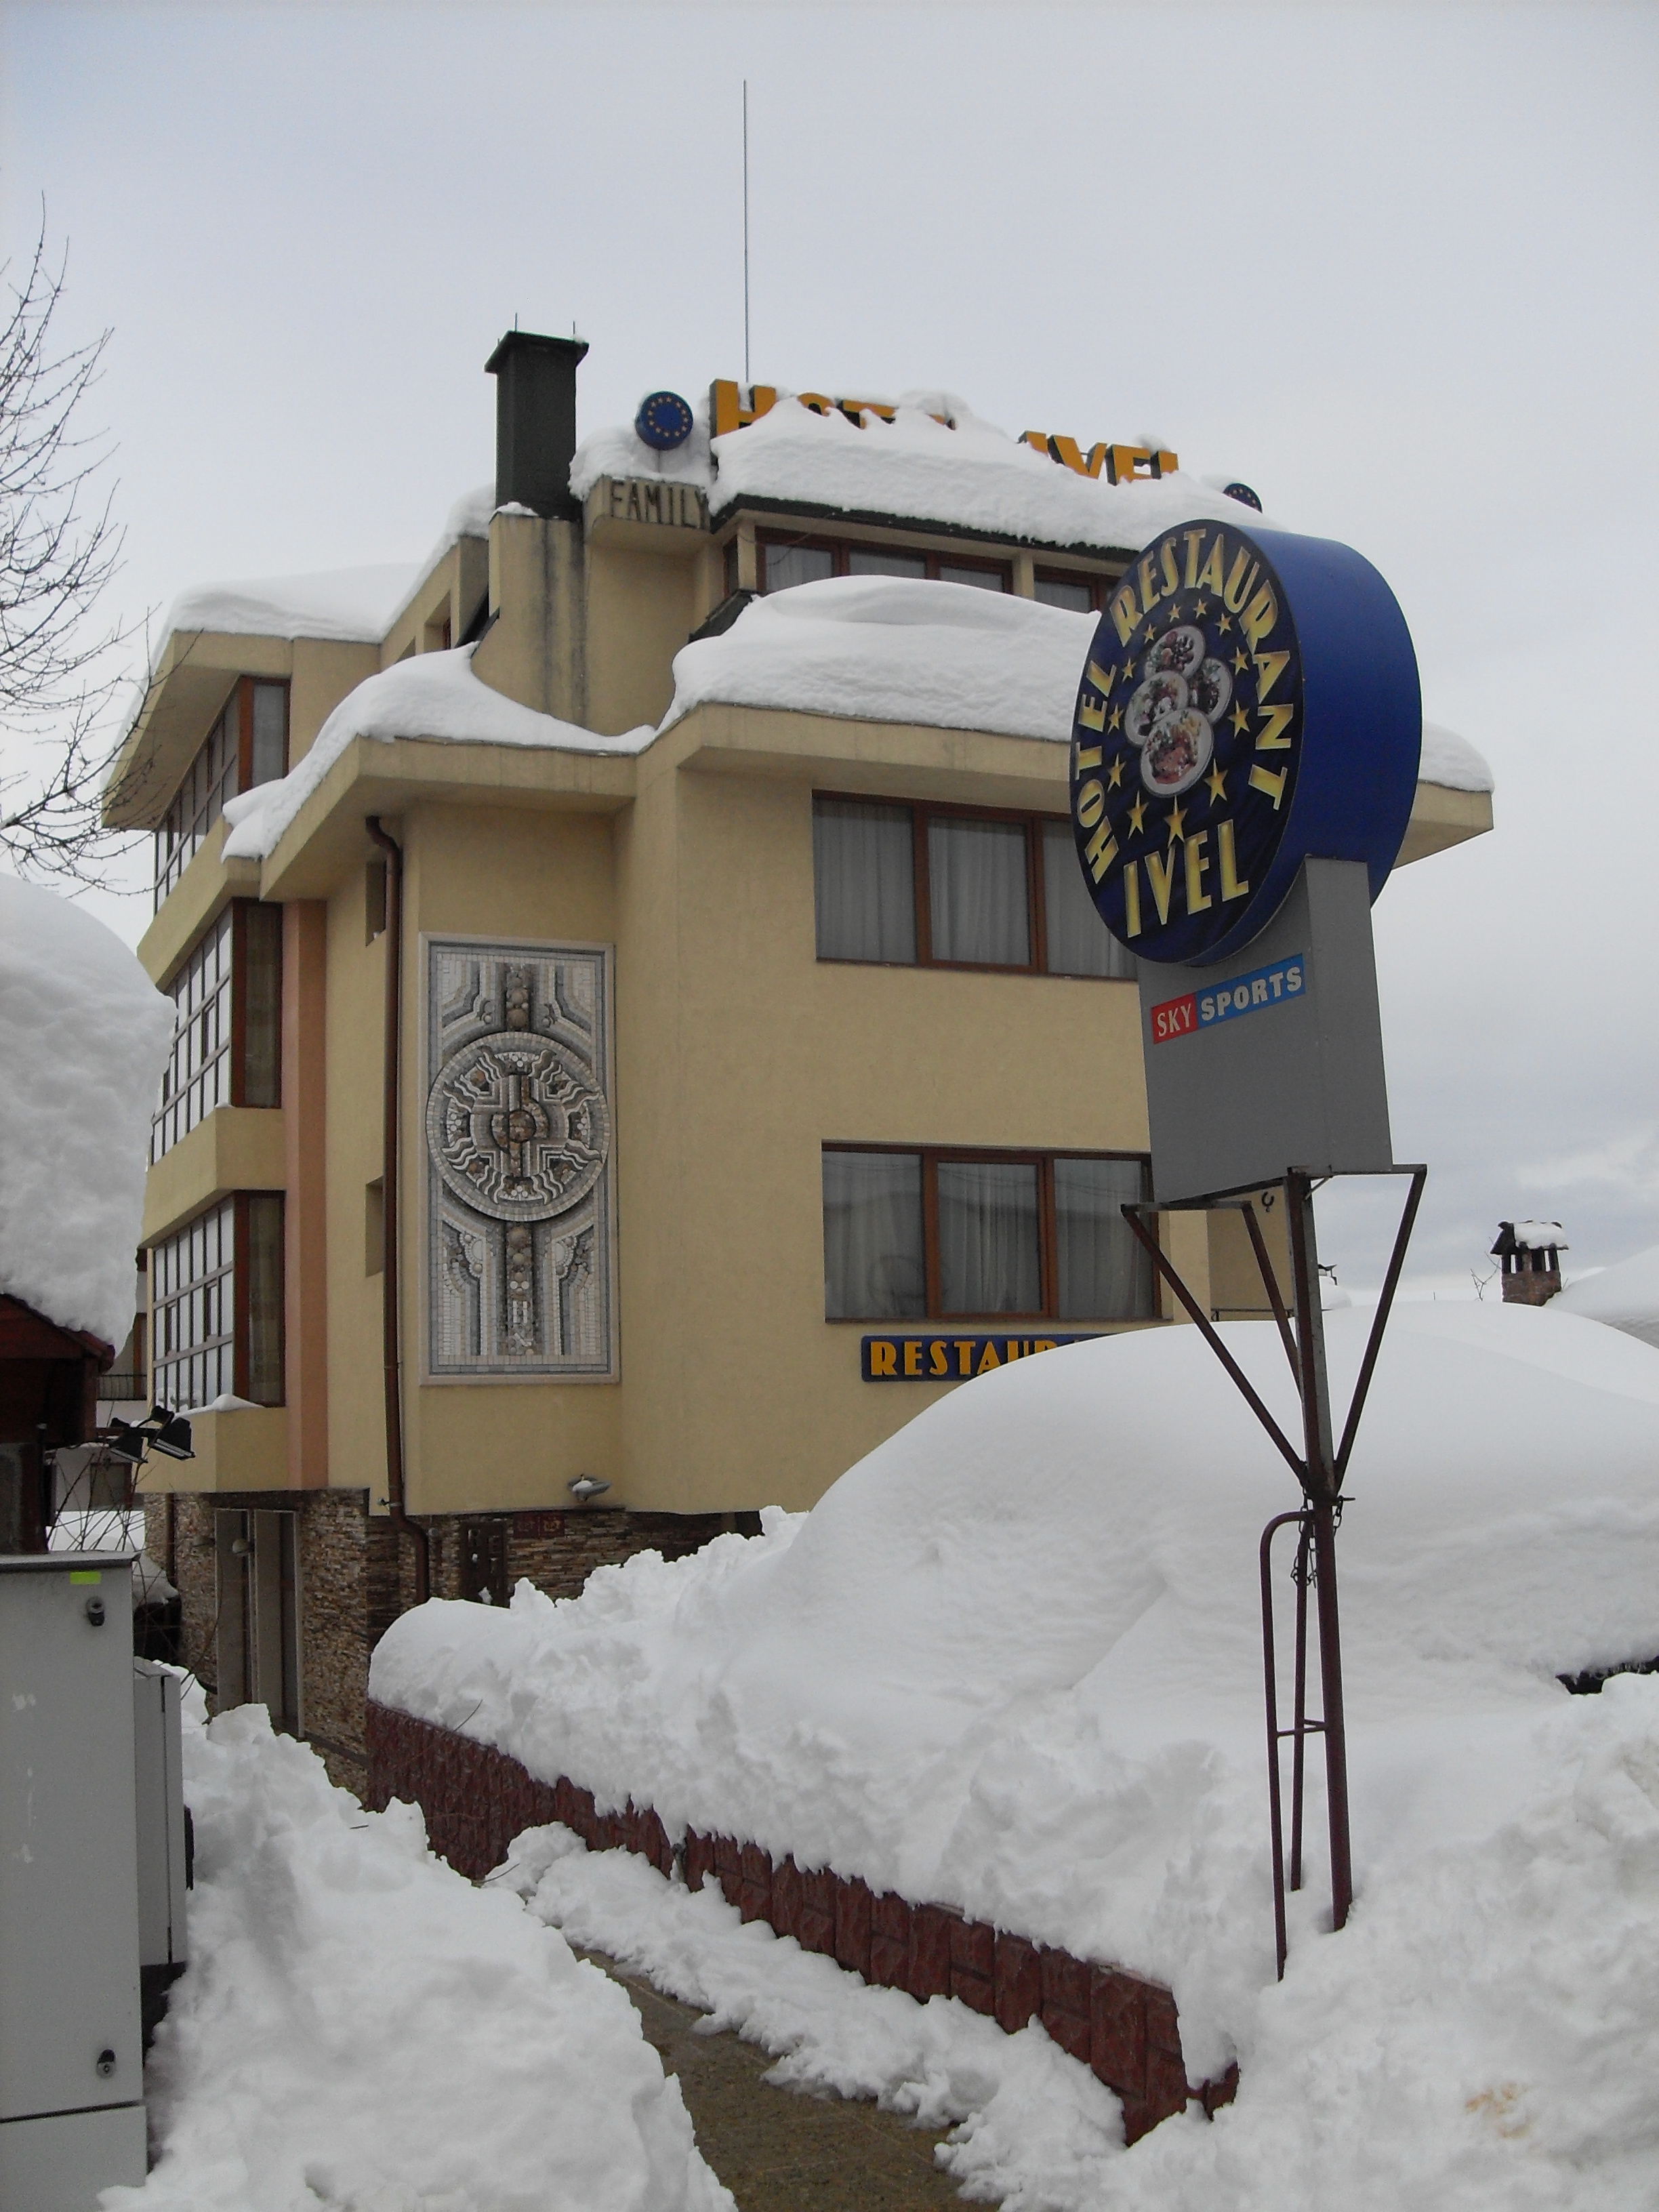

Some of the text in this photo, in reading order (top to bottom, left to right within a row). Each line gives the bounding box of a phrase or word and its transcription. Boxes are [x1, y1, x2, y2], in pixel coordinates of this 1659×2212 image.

[611, 480, 712, 529] FAMILY
[1075, 528, 1294, 884] HOTEL RESTAURANT
[1123, 819, 1249, 938] IVEL
[1157, 966, 1303, 1037] SKY SPORTS
[870, 1339, 1079, 1375] RESTAU
